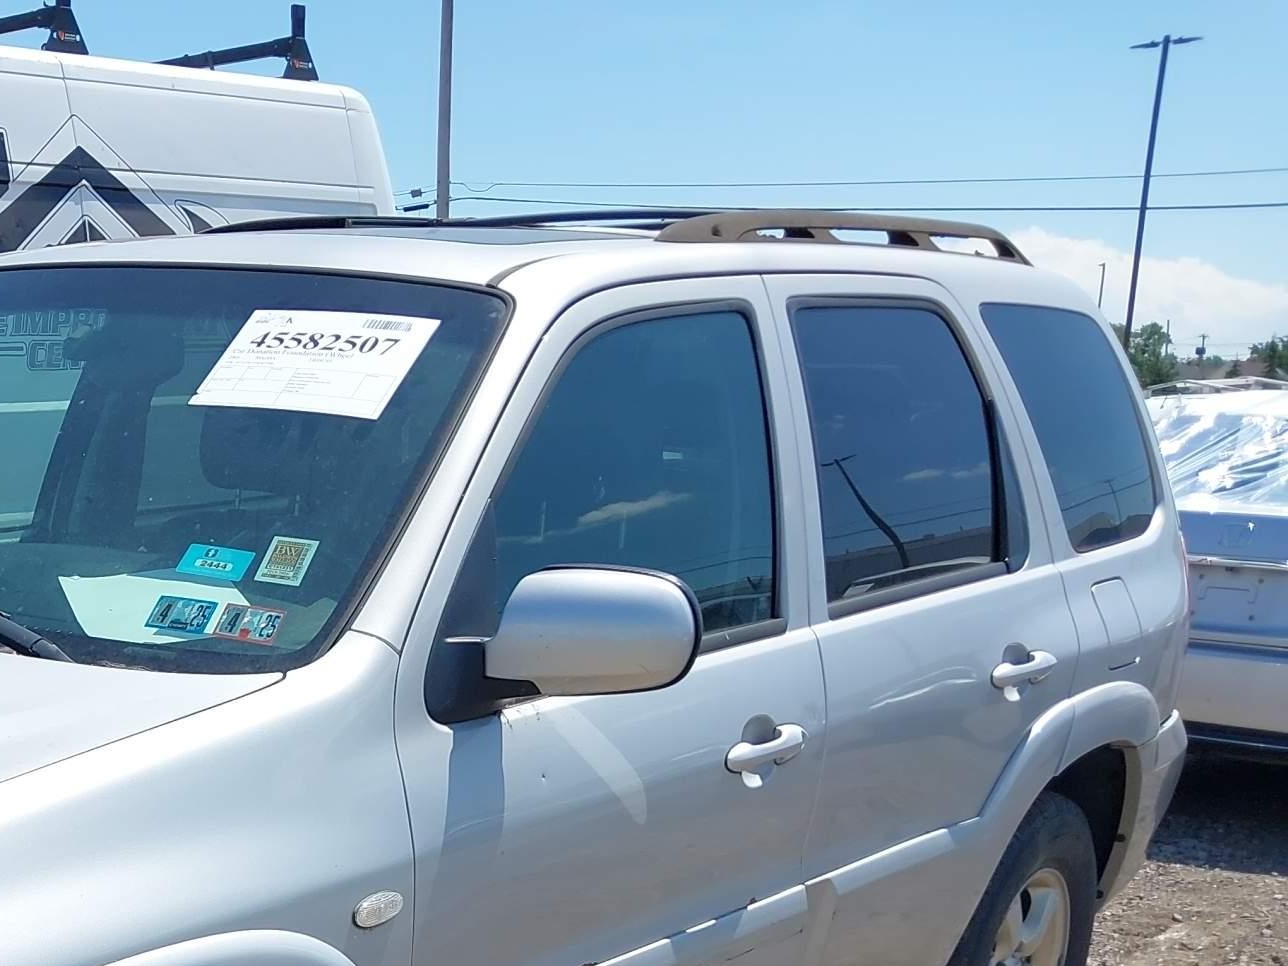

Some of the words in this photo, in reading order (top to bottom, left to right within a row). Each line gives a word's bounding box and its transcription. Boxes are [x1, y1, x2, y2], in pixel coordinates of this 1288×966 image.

[250, 331, 401, 356] 45582507
[199, 560, 228, 570] 2444
[157, 603, 173, 624] 4
[189, 604, 212, 628] 25
[224, 611, 241, 633] 4
[258, 614, 281, 639] 25
